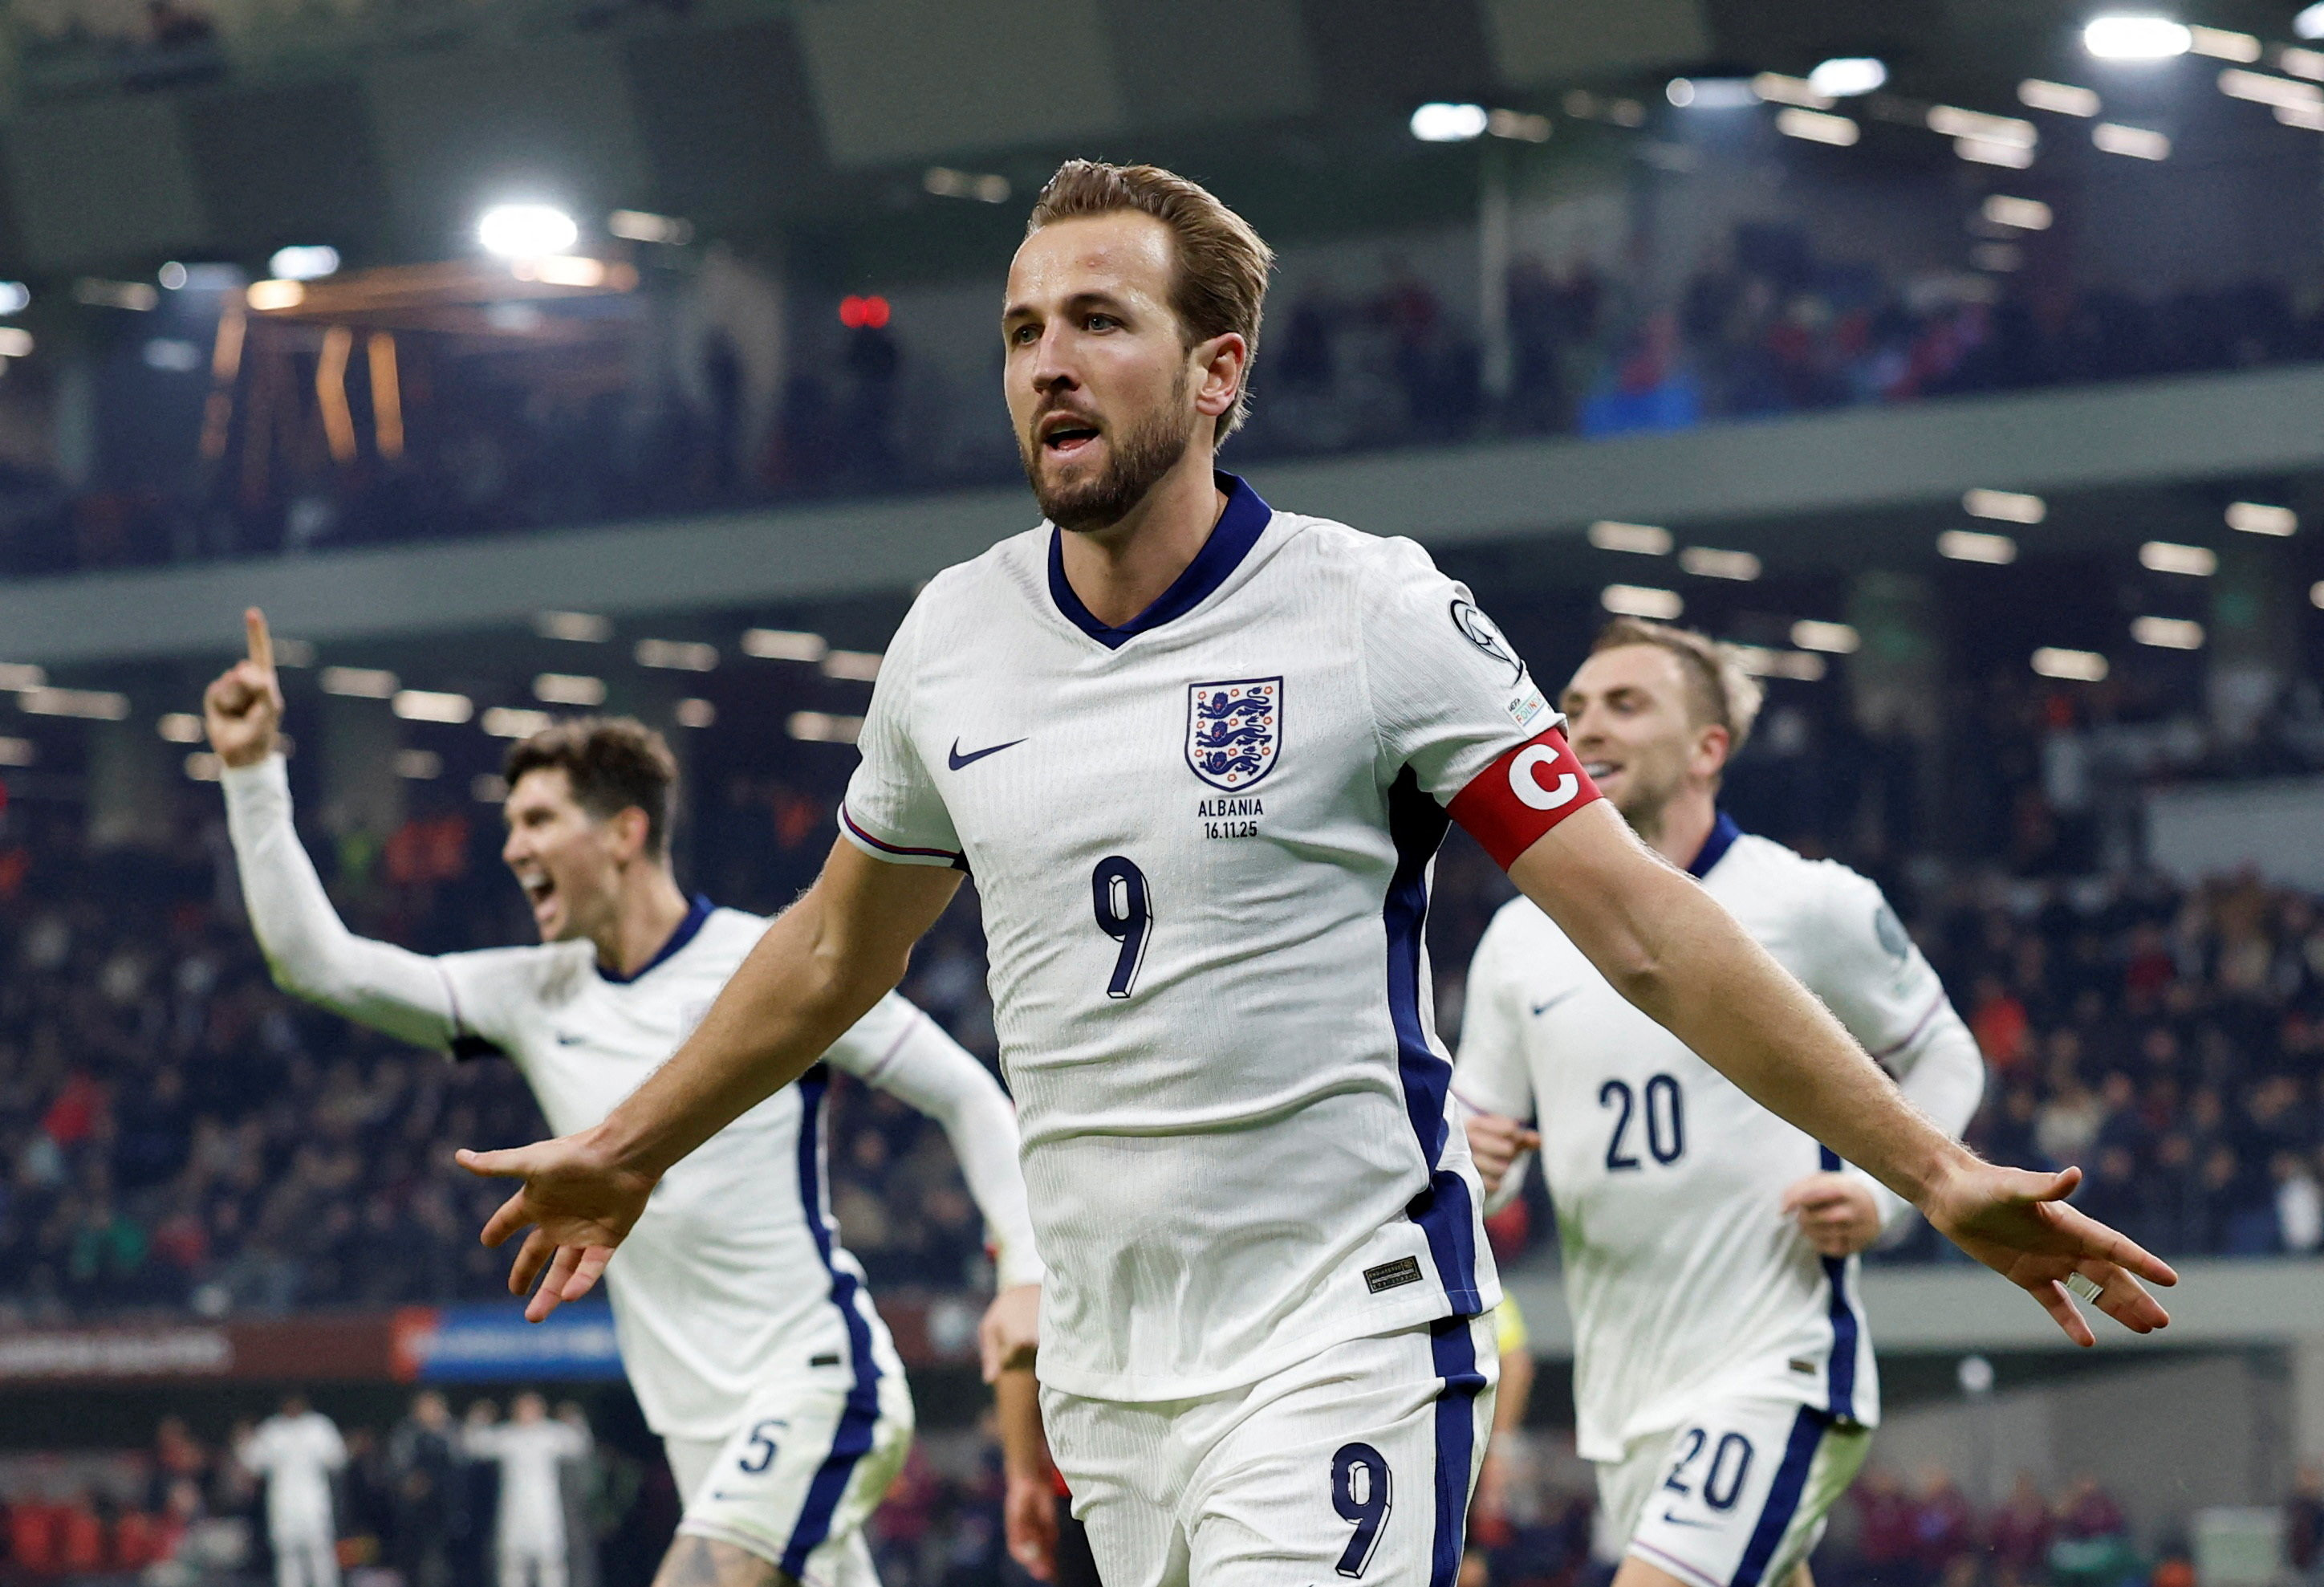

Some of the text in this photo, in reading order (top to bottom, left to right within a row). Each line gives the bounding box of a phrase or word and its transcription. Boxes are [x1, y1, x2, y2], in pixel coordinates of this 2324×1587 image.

[1198, 799, 1264, 817] ALBANIA
[1509, 743, 1579, 810] C
[1205, 821, 1257, 839] 16.11.25
[1092, 856, 1153, 999] 9
[1599, 1073, 1685, 1170] 20
[737, 1418, 790, 1474] 5
[1664, 1427, 1753, 1511] 20
[1331, 1443, 1392, 1580] 9
